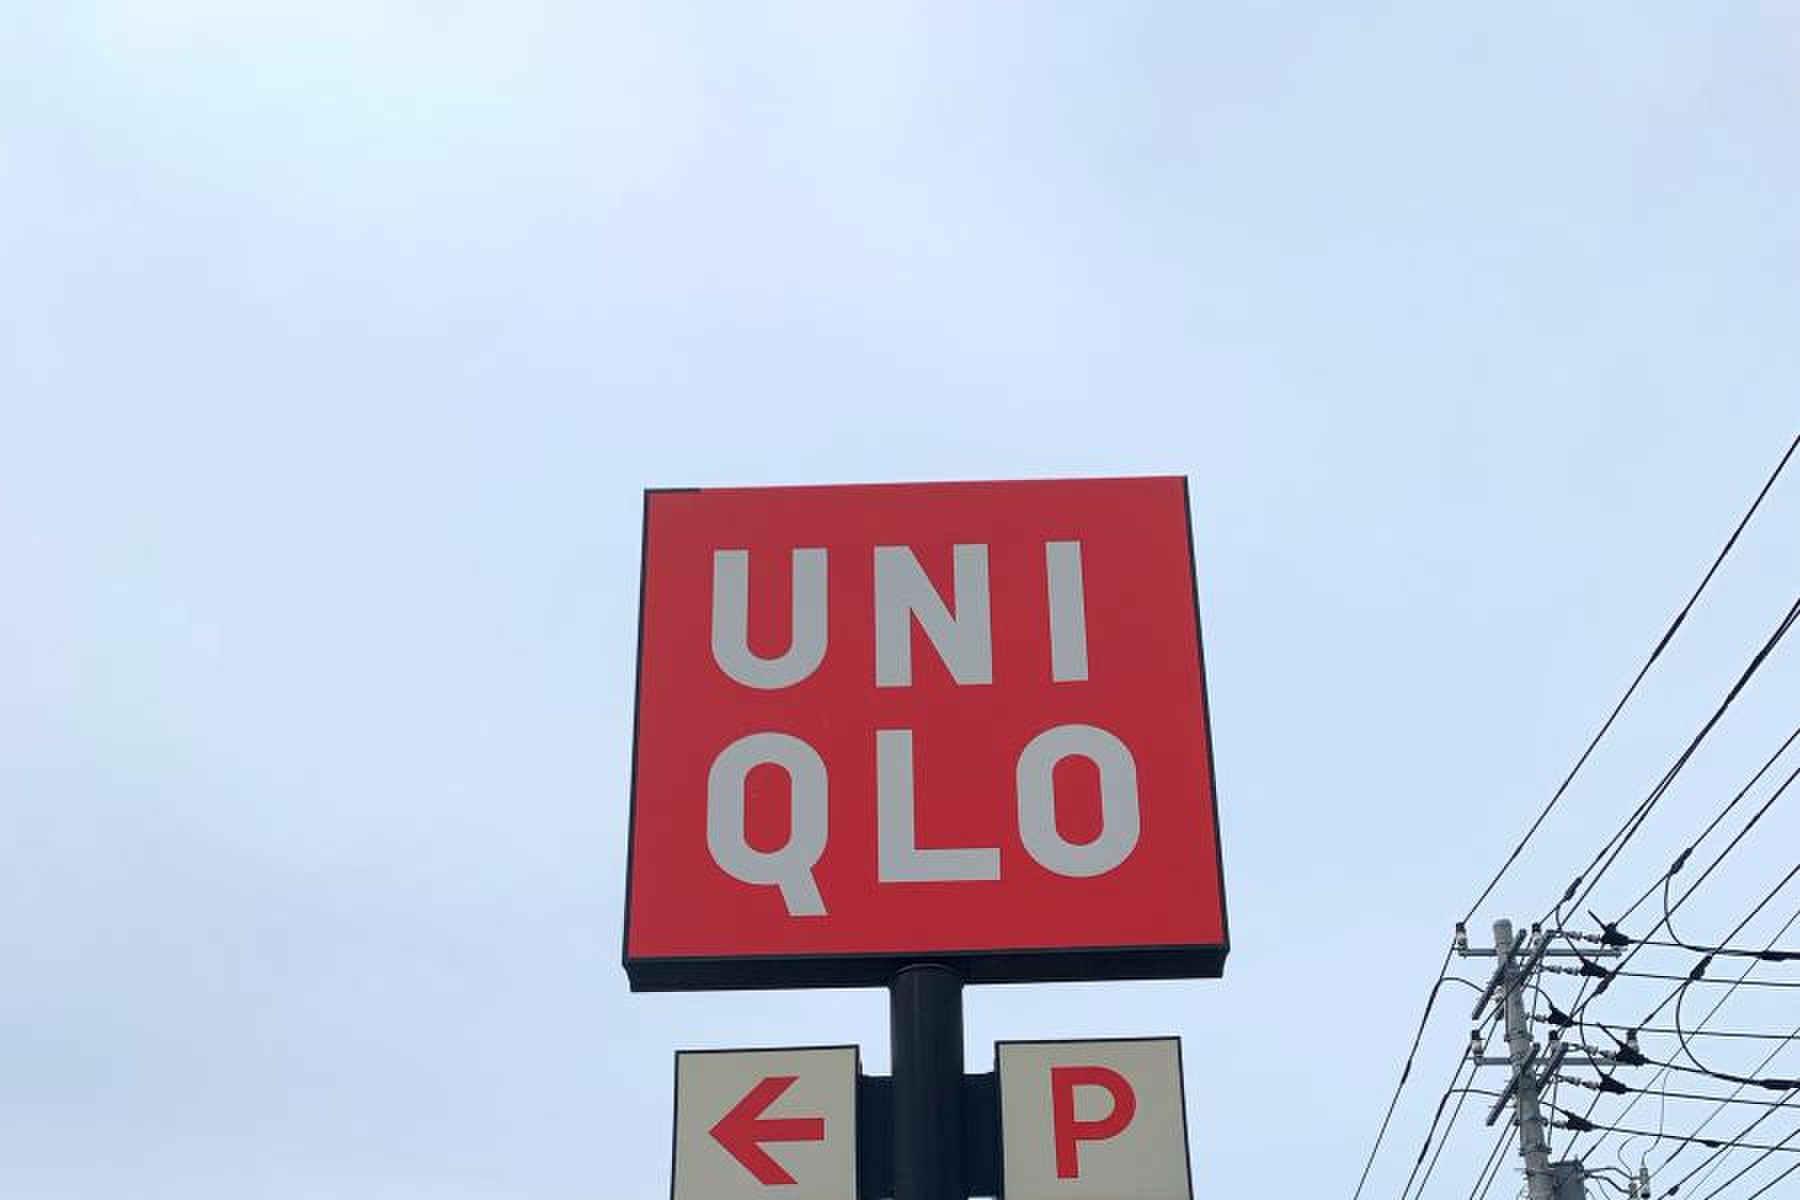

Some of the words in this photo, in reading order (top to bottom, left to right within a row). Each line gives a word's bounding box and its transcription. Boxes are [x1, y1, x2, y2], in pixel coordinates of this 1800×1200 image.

[710, 539, 1089, 690] UNI
[706, 723, 1141, 917] QLO
[1050, 1065, 1137, 1179] P
